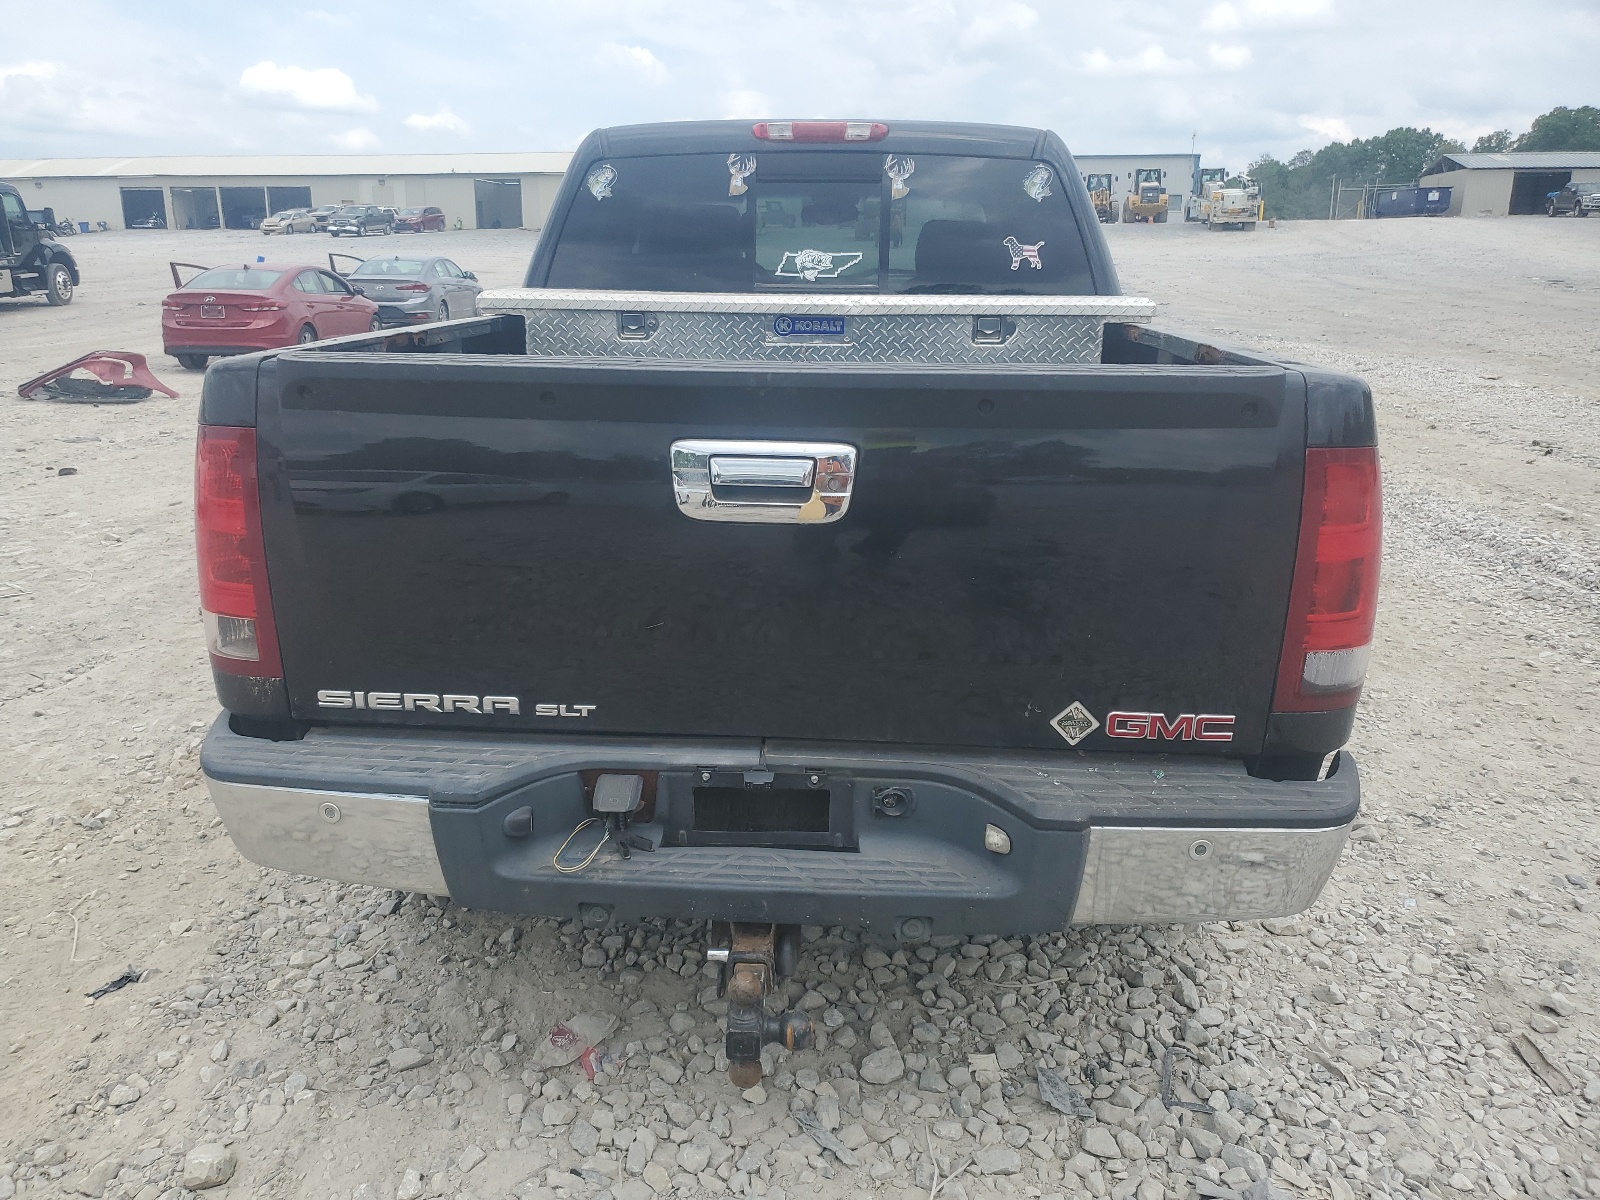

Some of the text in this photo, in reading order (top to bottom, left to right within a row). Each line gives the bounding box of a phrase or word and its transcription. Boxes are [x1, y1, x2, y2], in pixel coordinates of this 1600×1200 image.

[795, 320, 842, 332] KOBALT
[317, 689, 597, 717] SIERRA SLT
[1106, 711, 1236, 741] GMC
